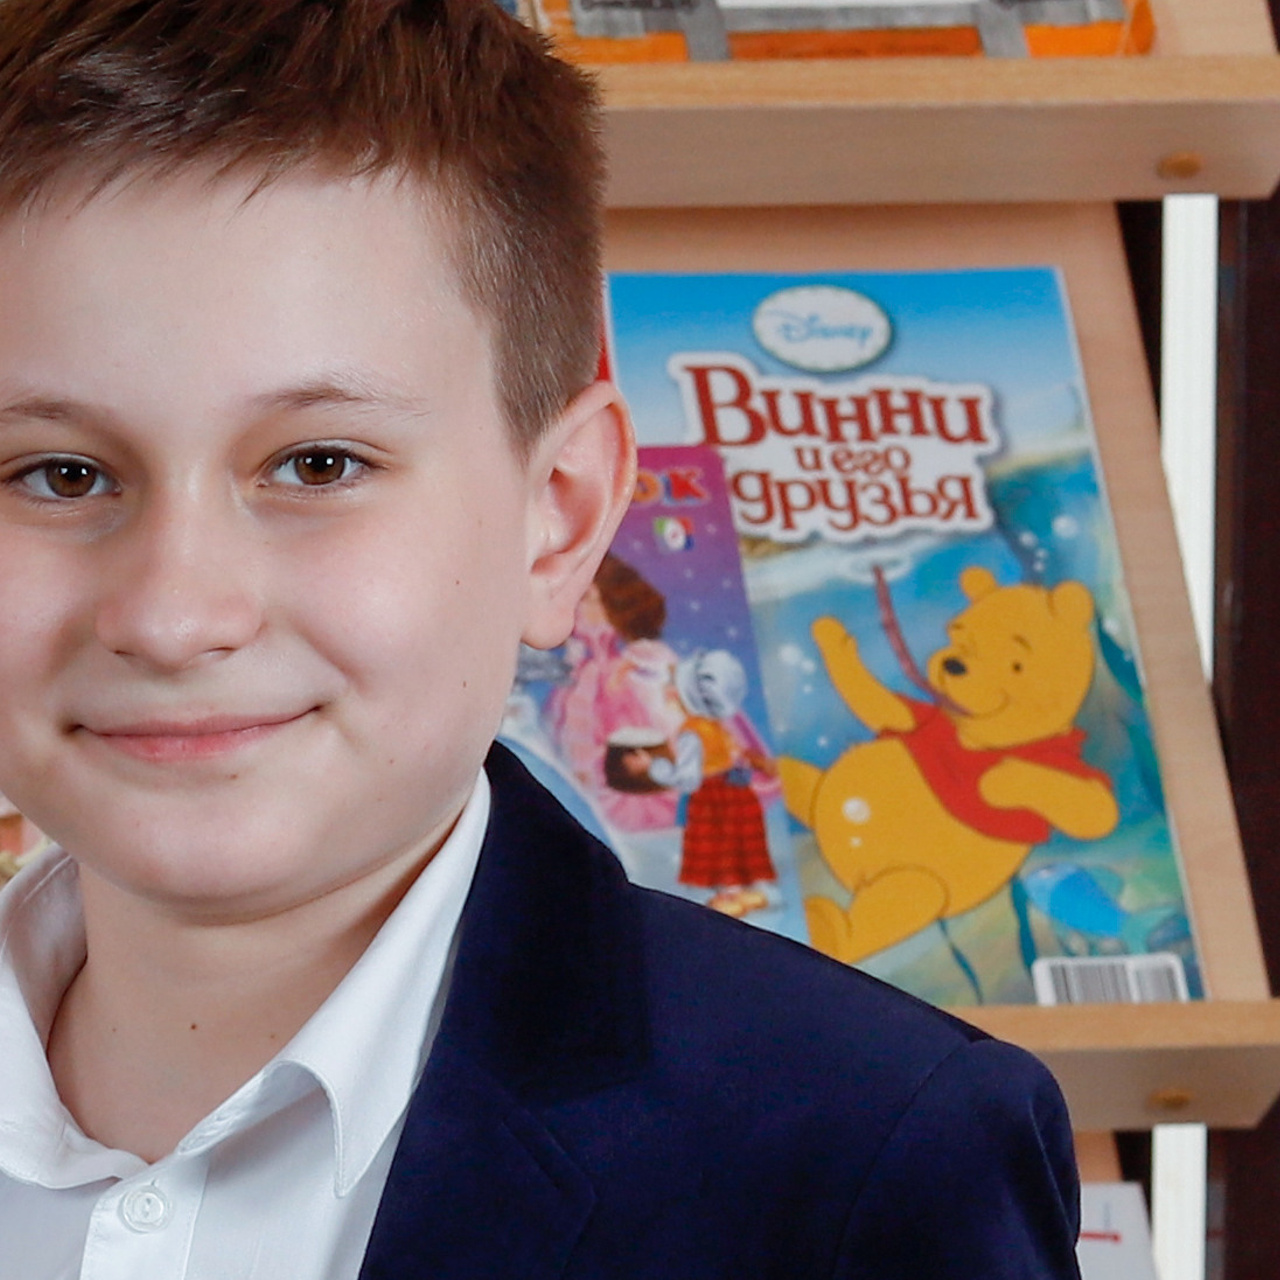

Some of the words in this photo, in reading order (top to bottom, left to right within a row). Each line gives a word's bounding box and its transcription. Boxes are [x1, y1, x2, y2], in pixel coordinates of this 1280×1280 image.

[771, 312, 874, 347] Disney
[683, 366, 989, 447] Винни
[795, 446, 822, 470] и
[832, 445, 912, 475] его
[731, 469, 981, 532] друзья
